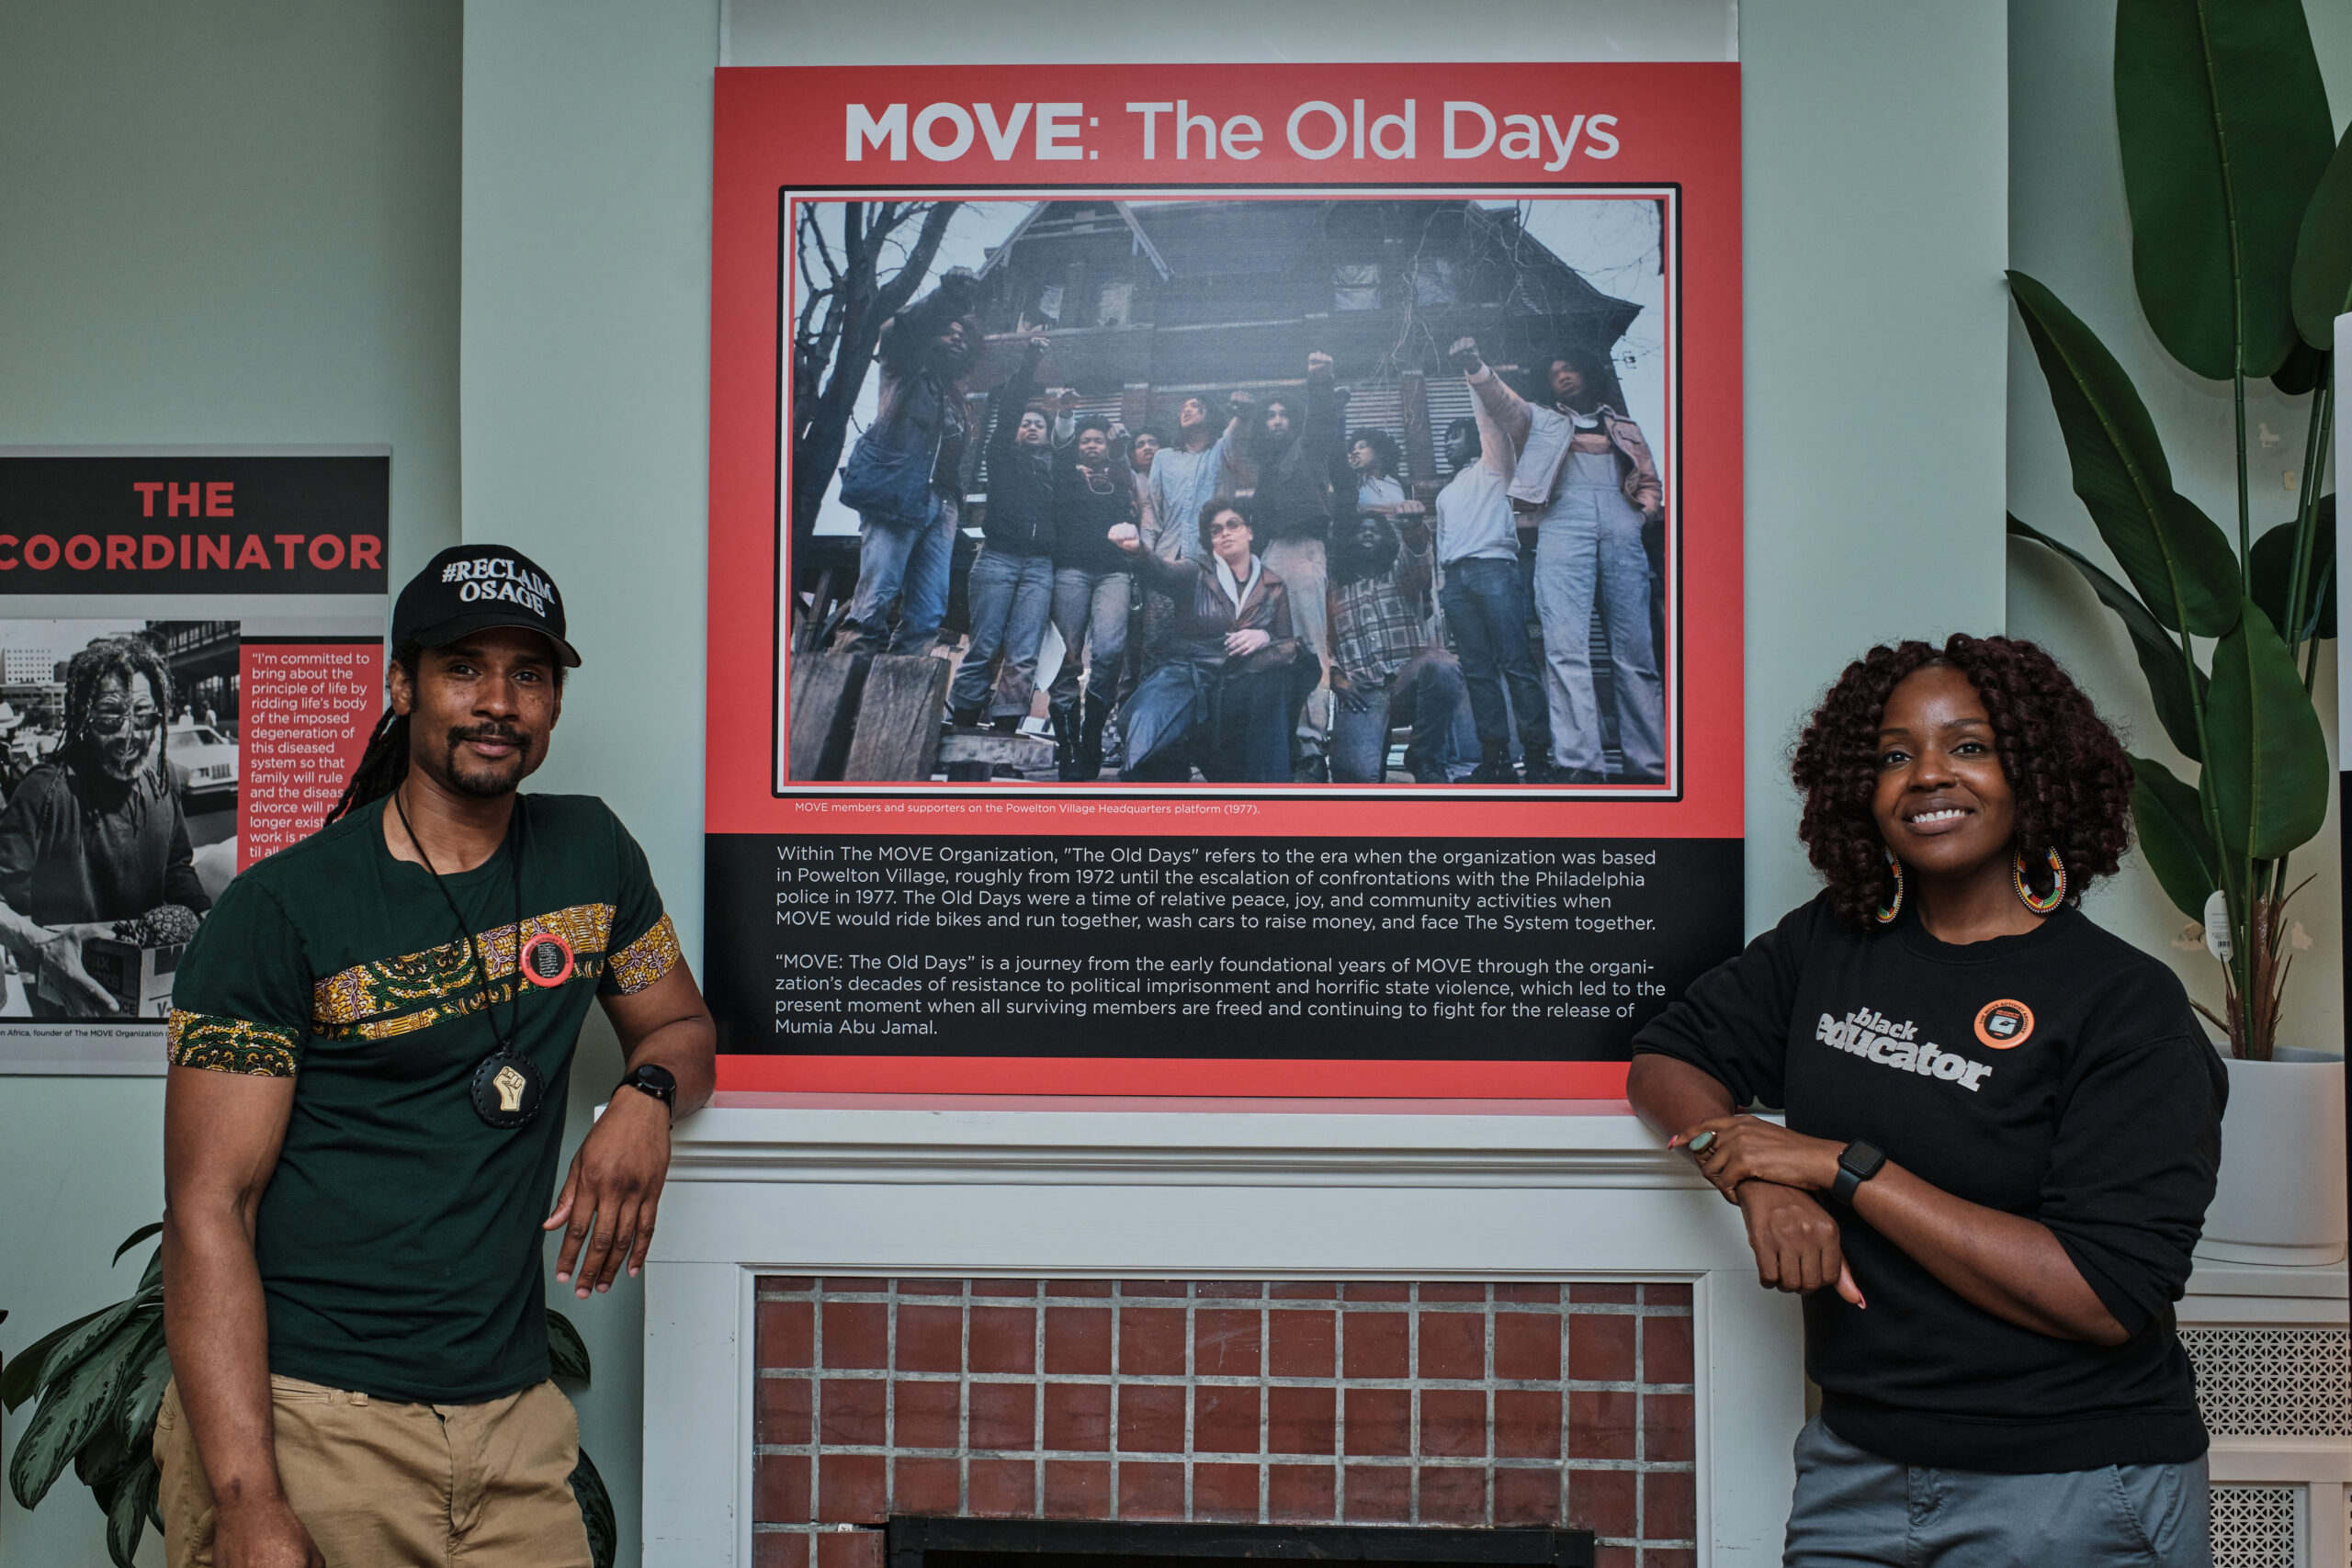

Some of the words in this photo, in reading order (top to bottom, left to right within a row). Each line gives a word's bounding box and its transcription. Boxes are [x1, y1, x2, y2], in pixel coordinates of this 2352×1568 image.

[845, 102, 1099, 162] MOVE:
[1125, 99, 1263, 161] The
[1286, 98, 1416, 160] Old
[1443, 100, 1620, 172] Days
[133, 481, 234, 517] THE
[0, 534, 382, 570] COORDINATOR
[442, 558, 555, 604] #RECLAIM
[459, 580, 546, 618] OSAGE
[281, 652, 352, 664] committed
[356, 653, 369, 664] to
[253, 667, 286, 681] bring
[289, 668, 328, 679] about
[332, 668, 353, 679] the
[252, 682, 308, 696] principle
[311, 682, 324, 694] of
[329, 682, 347, 694] life
[351, 682, 367, 696] by
[252, 697, 298, 711] ridding
[302, 697, 329, 709] life’s
[334, 697, 367, 711] body
[252, 712, 265, 724] of
[268, 712, 289, 724] the
[294, 712, 349, 726] imposed
[251, 727, 337, 740] degeneration
[341, 727, 355, 739] of
[251, 741, 274, 753] this
[278, 741, 334, 753] diseased
[251, 757, 296, 770] system
[300, 759, 315, 768] so
[320, 757, 345, 768] that
[251, 771, 289, 785] family
[294, 772, 314, 783] will
[319, 772, 343, 784] rule
[250, 786, 275, 798] and
[278, 786, 300, 798] the
[303, 786, 344, 798] diseas
[250, 801, 298, 813] divorce
[302, 801, 322, 813] will
[795, 801, 829, 812] MOVE
[831, 802, 882, 813] members
[884, 802, 905, 813] and
[907, 803, 967, 814] supporters
[967, 805, 983, 813] on
[985, 803, 1003, 813] the
[1006, 803, 1057, 813] Powelton
[1058, 803, 1096, 816] Village
[1098, 803, 1172, 816] Headquarters
[1174, 803, 1221, 816] platform
[1224, 804, 1261, 816] (1977).
[250, 817, 291, 829] longer
[250, 831, 281, 842] work
[286, 831, 295, 842] is
[776, 845, 834, 861] Within
[840, 845, 873, 862] The
[878, 846, 933, 862] MOVE
[939, 846, 1058, 864] Organization,
[1111, 847, 1142, 863] Old
[1204, 847, 1256, 863] refers
[1261, 848, 1280, 863] to
[1285, 848, 1315, 863] the
[1320, 852, 1348, 864] era
[1353, 848, 1402, 864] when
[1408, 848, 1438, 864] the
[1442, 849, 1555, 867] organization
[1561, 852, 1596, 865] was
[1601, 849, 1656, 865] based
[776, 867, 792, 883] in
[797, 867, 879, 883] Powelton
[885, 867, 949, 886] Village,
[956, 868, 1023, 886] roughly
[1028, 868, 1070, 885] from
[1075, 869, 1114, 885] 1972
[1120, 869, 1159, 885] until
[1164, 869, 1194, 885] the
[1199, 869, 1290, 886] escalation
[1295, 870, 1315, 886] of
[1318, 870, 1451, 886] confrontations
[1455, 870, 1495, 886] with
[1499, 870, 1530, 886] the
[1536, 871, 1645, 890] Philadelphia
[776, 910, 831, 926] MOVE
[836, 910, 890, 927] would
[896, 910, 931, 927] ride
[936, 910, 982, 927] bikes
[987, 911, 1020, 927] and
[1026, 915, 1055, 928] run
[1060, 912, 1141, 931] together,
[1147, 912, 1193, 929] wash
[1197, 916, 1235, 929] cars
[1240, 914, 1260, 929] to
[1265, 913, 1306, 929] raise
[1312, 917, 1376, 932] money,
[1381, 914, 1415, 930] and
[1420, 914, 1459, 930] face
[1464, 914, 1498, 931] The
[1503, 914, 1569, 933] System
[1574, 915, 1656, 933] together.
[848, 953, 882, 970] The
[887, 953, 919, 970] Old
[981, 954, 994, 970] is
[1000, 958, 1010, 971] a
[1014, 954, 1082, 974] journey
[1087, 955, 1130, 971] from
[1135, 955, 1165, 972] the
[1170, 955, 1215, 975] early
[1219, 956, 1332, 973] foundational
[1338, 961, 1386, 976] years
[1391, 957, 1411, 973] of
[1416, 957, 1472, 974] MOVE
[1476, 957, 1549, 976] through
[1554, 958, 1585, 975] the
[1589, 959, 1655, 977] organi-
[775, 998, 842, 1015] present
[847, 998, 922, 1013] moment
[927, 998, 975, 1014] when
[980, 998, 1001, 1014] all
[1006, 998, 1087, 1018] surviving
[1092, 999, 1177, 1015] members
[1182, 1003, 1210, 1016] are
[1215, 999, 1262, 1016] freed
[1268, 1000, 1302, 1016] and
[1307, 1000, 1403, 1020] continuing
[1408, 1002, 1428, 1017] to
[1432, 1001, 1476, 1020] fight
[1480, 1001, 1507, 1018] for
[1511, 1001, 1542, 1018] the
[1547, 1001, 1611, 1018] release
[1615, 1002, 1635, 1019] of
[775, 1018, 833, 1034] Mumia
[838, 1019, 876, 1034] Abu
[880, 1019, 938, 1035] Jamal.
[1854, 1007, 1918, 1041] black
[7, 1029, 32, 1039] Africa,
[33, 1029, 62, 1038] founder
[64, 1029, 73, 1038] of
[75, 1029, 88, 1038] The
[90, 1029, 113, 1038] MOVE
[115, 1030, 164, 1040] Organization
[1815, 1012, 1993, 1092] educator
